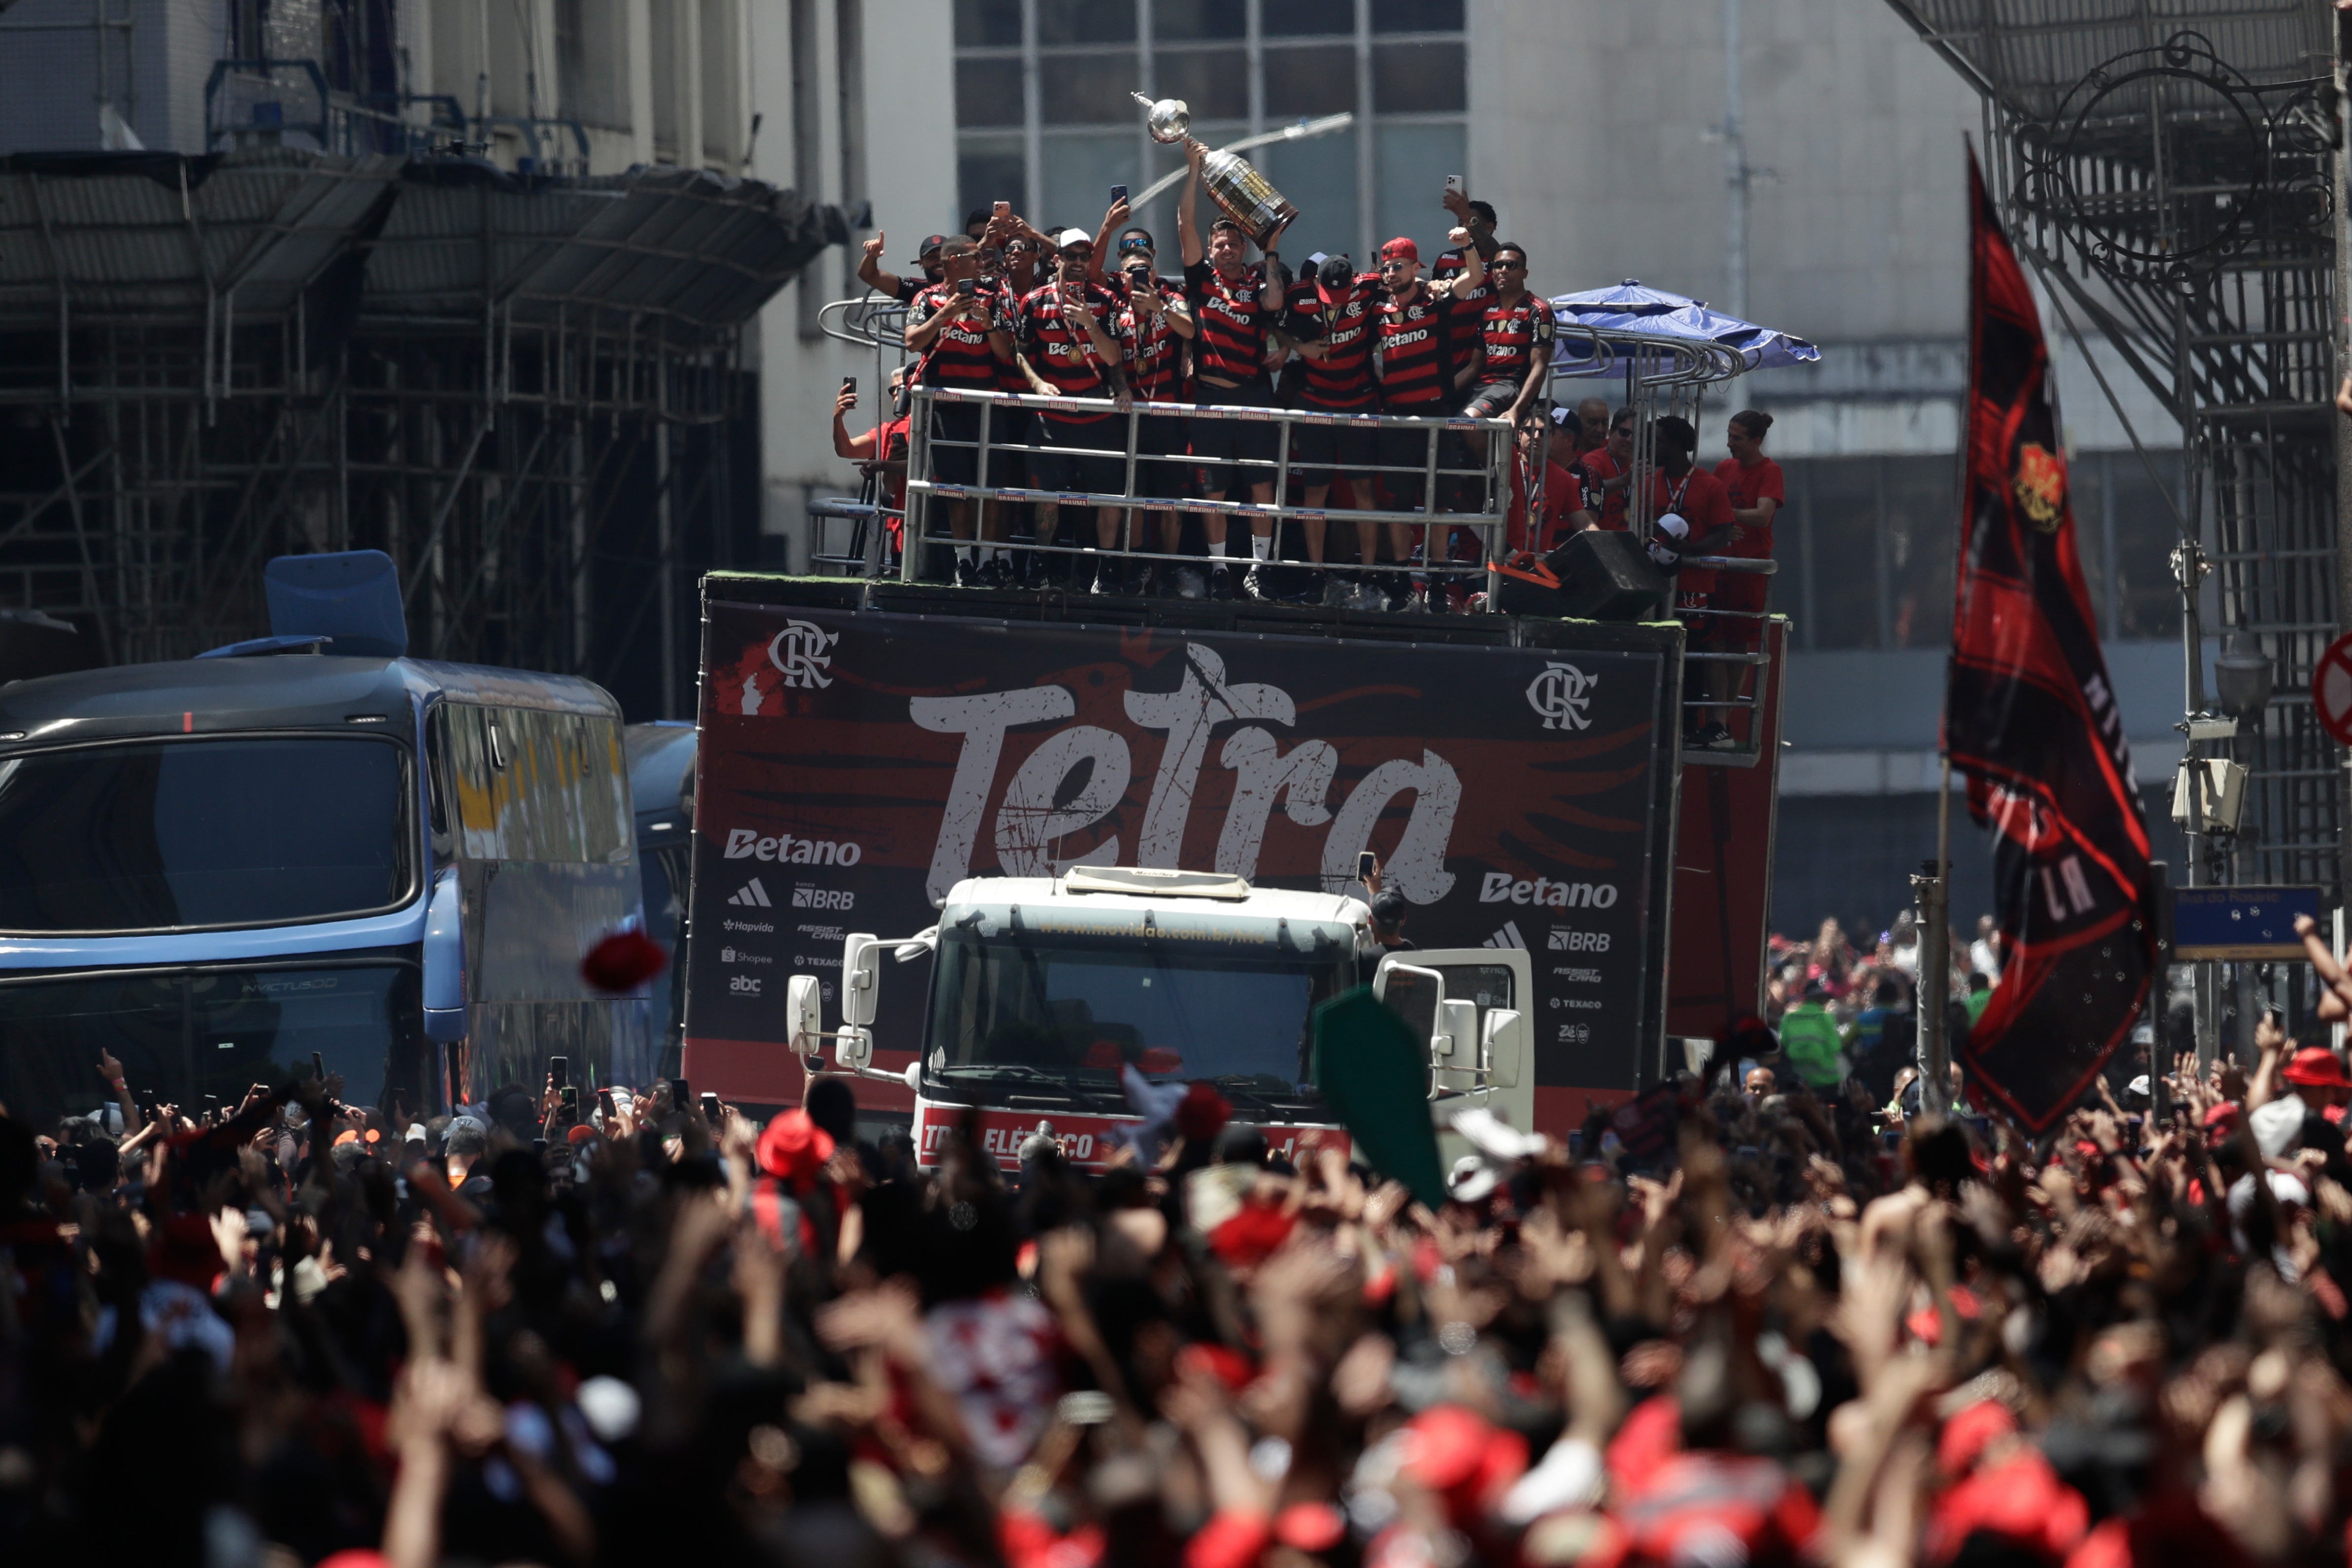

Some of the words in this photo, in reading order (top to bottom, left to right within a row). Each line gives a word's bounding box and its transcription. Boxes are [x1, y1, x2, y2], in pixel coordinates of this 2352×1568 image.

[935, 392, 961, 401] BRAHMA
[1050, 401, 1076, 410] BRAHMA
[1241, 412, 1268, 420] BRAHMA
[1305, 416, 1333, 425] BRAHMA
[909, 643, 1461, 905] Tetra
[724, 829, 861, 867] Betano
[1480, 872, 1618, 909] Betano
[813, 889, 855, 910] BRB
[734, 921, 774, 933] Hapvida
[797, 924, 843, 934] ASSIST
[812, 932, 846, 941] CARD
[1569, 932, 1611, 952] BRB
[738, 952, 772, 965] Shopee
[730, 975, 761, 992] abc
[1568, 974, 1602, 983] CARD
[242, 981, 312, 992] INVICTUS
[1563, 1000, 1602, 1009] TEXACO
